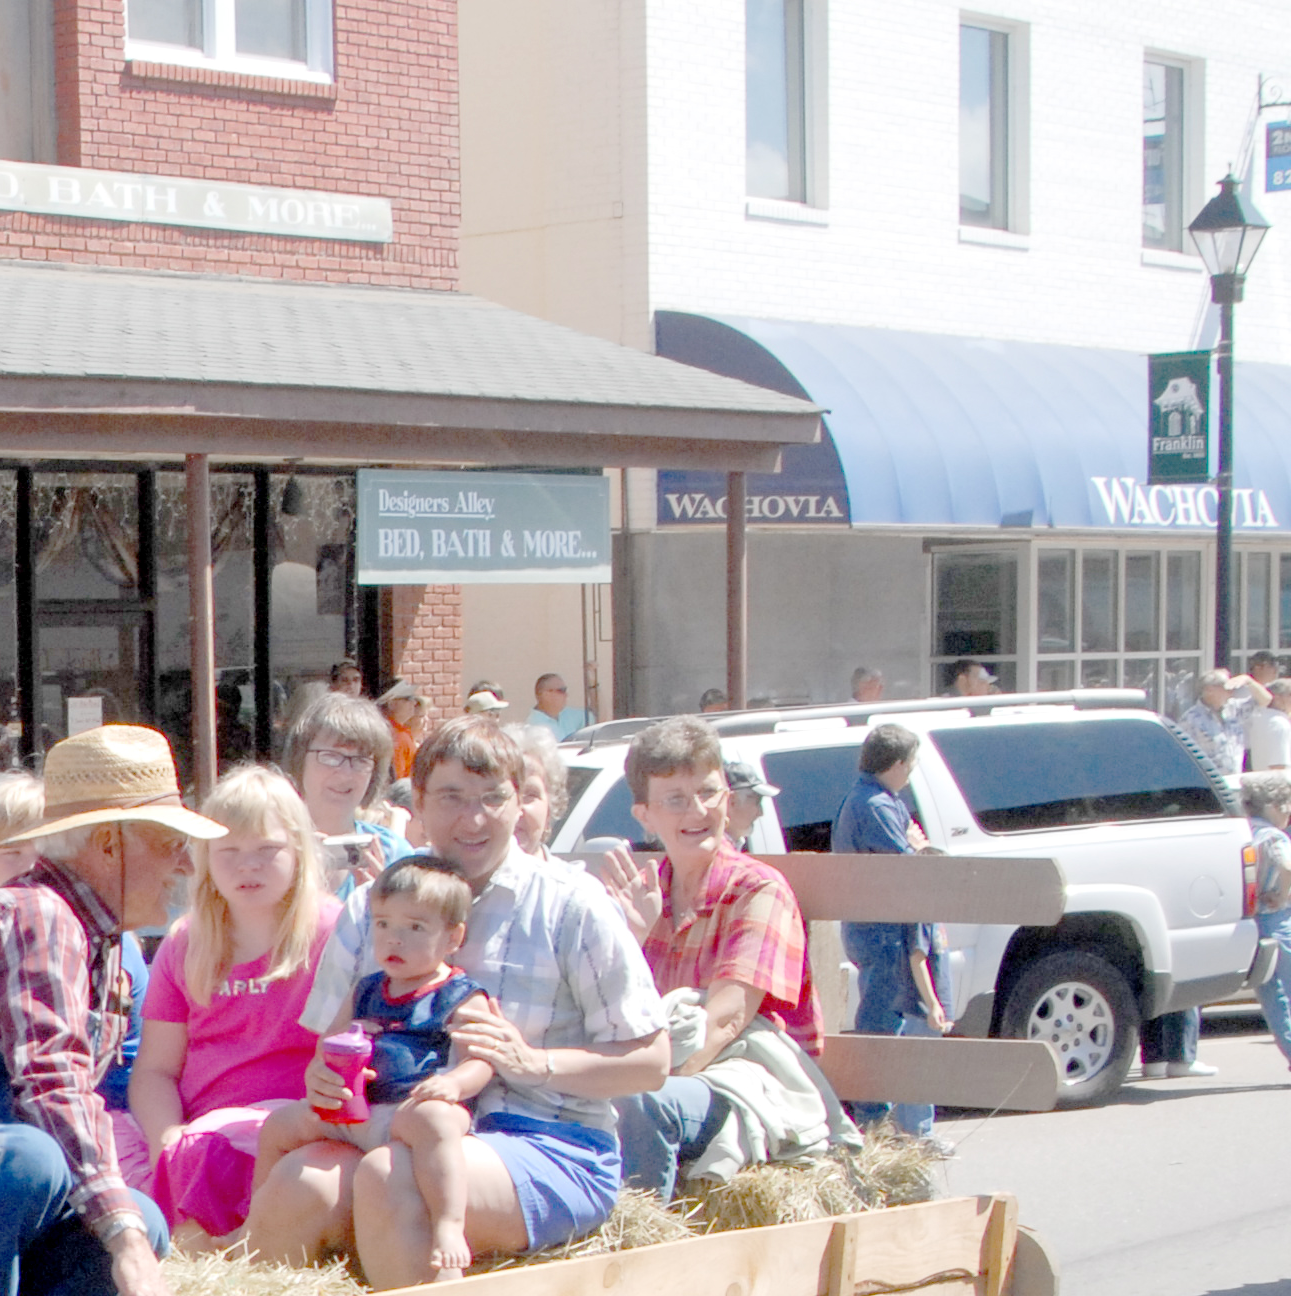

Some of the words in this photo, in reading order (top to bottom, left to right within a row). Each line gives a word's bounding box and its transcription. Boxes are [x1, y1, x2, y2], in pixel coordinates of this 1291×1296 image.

[48, 175, 178, 214] BATH
[202, 192, 227, 218] &
[1152, 435, 1204, 452] Franklin
[378, 488, 450, 518] Designers
[454, 491, 496, 520] Alley
[378, 528, 425, 561] BED,
[431, 529, 492, 558] BATH
[500, 529, 517, 558] &
[522, 530, 598, 559] MORE...
